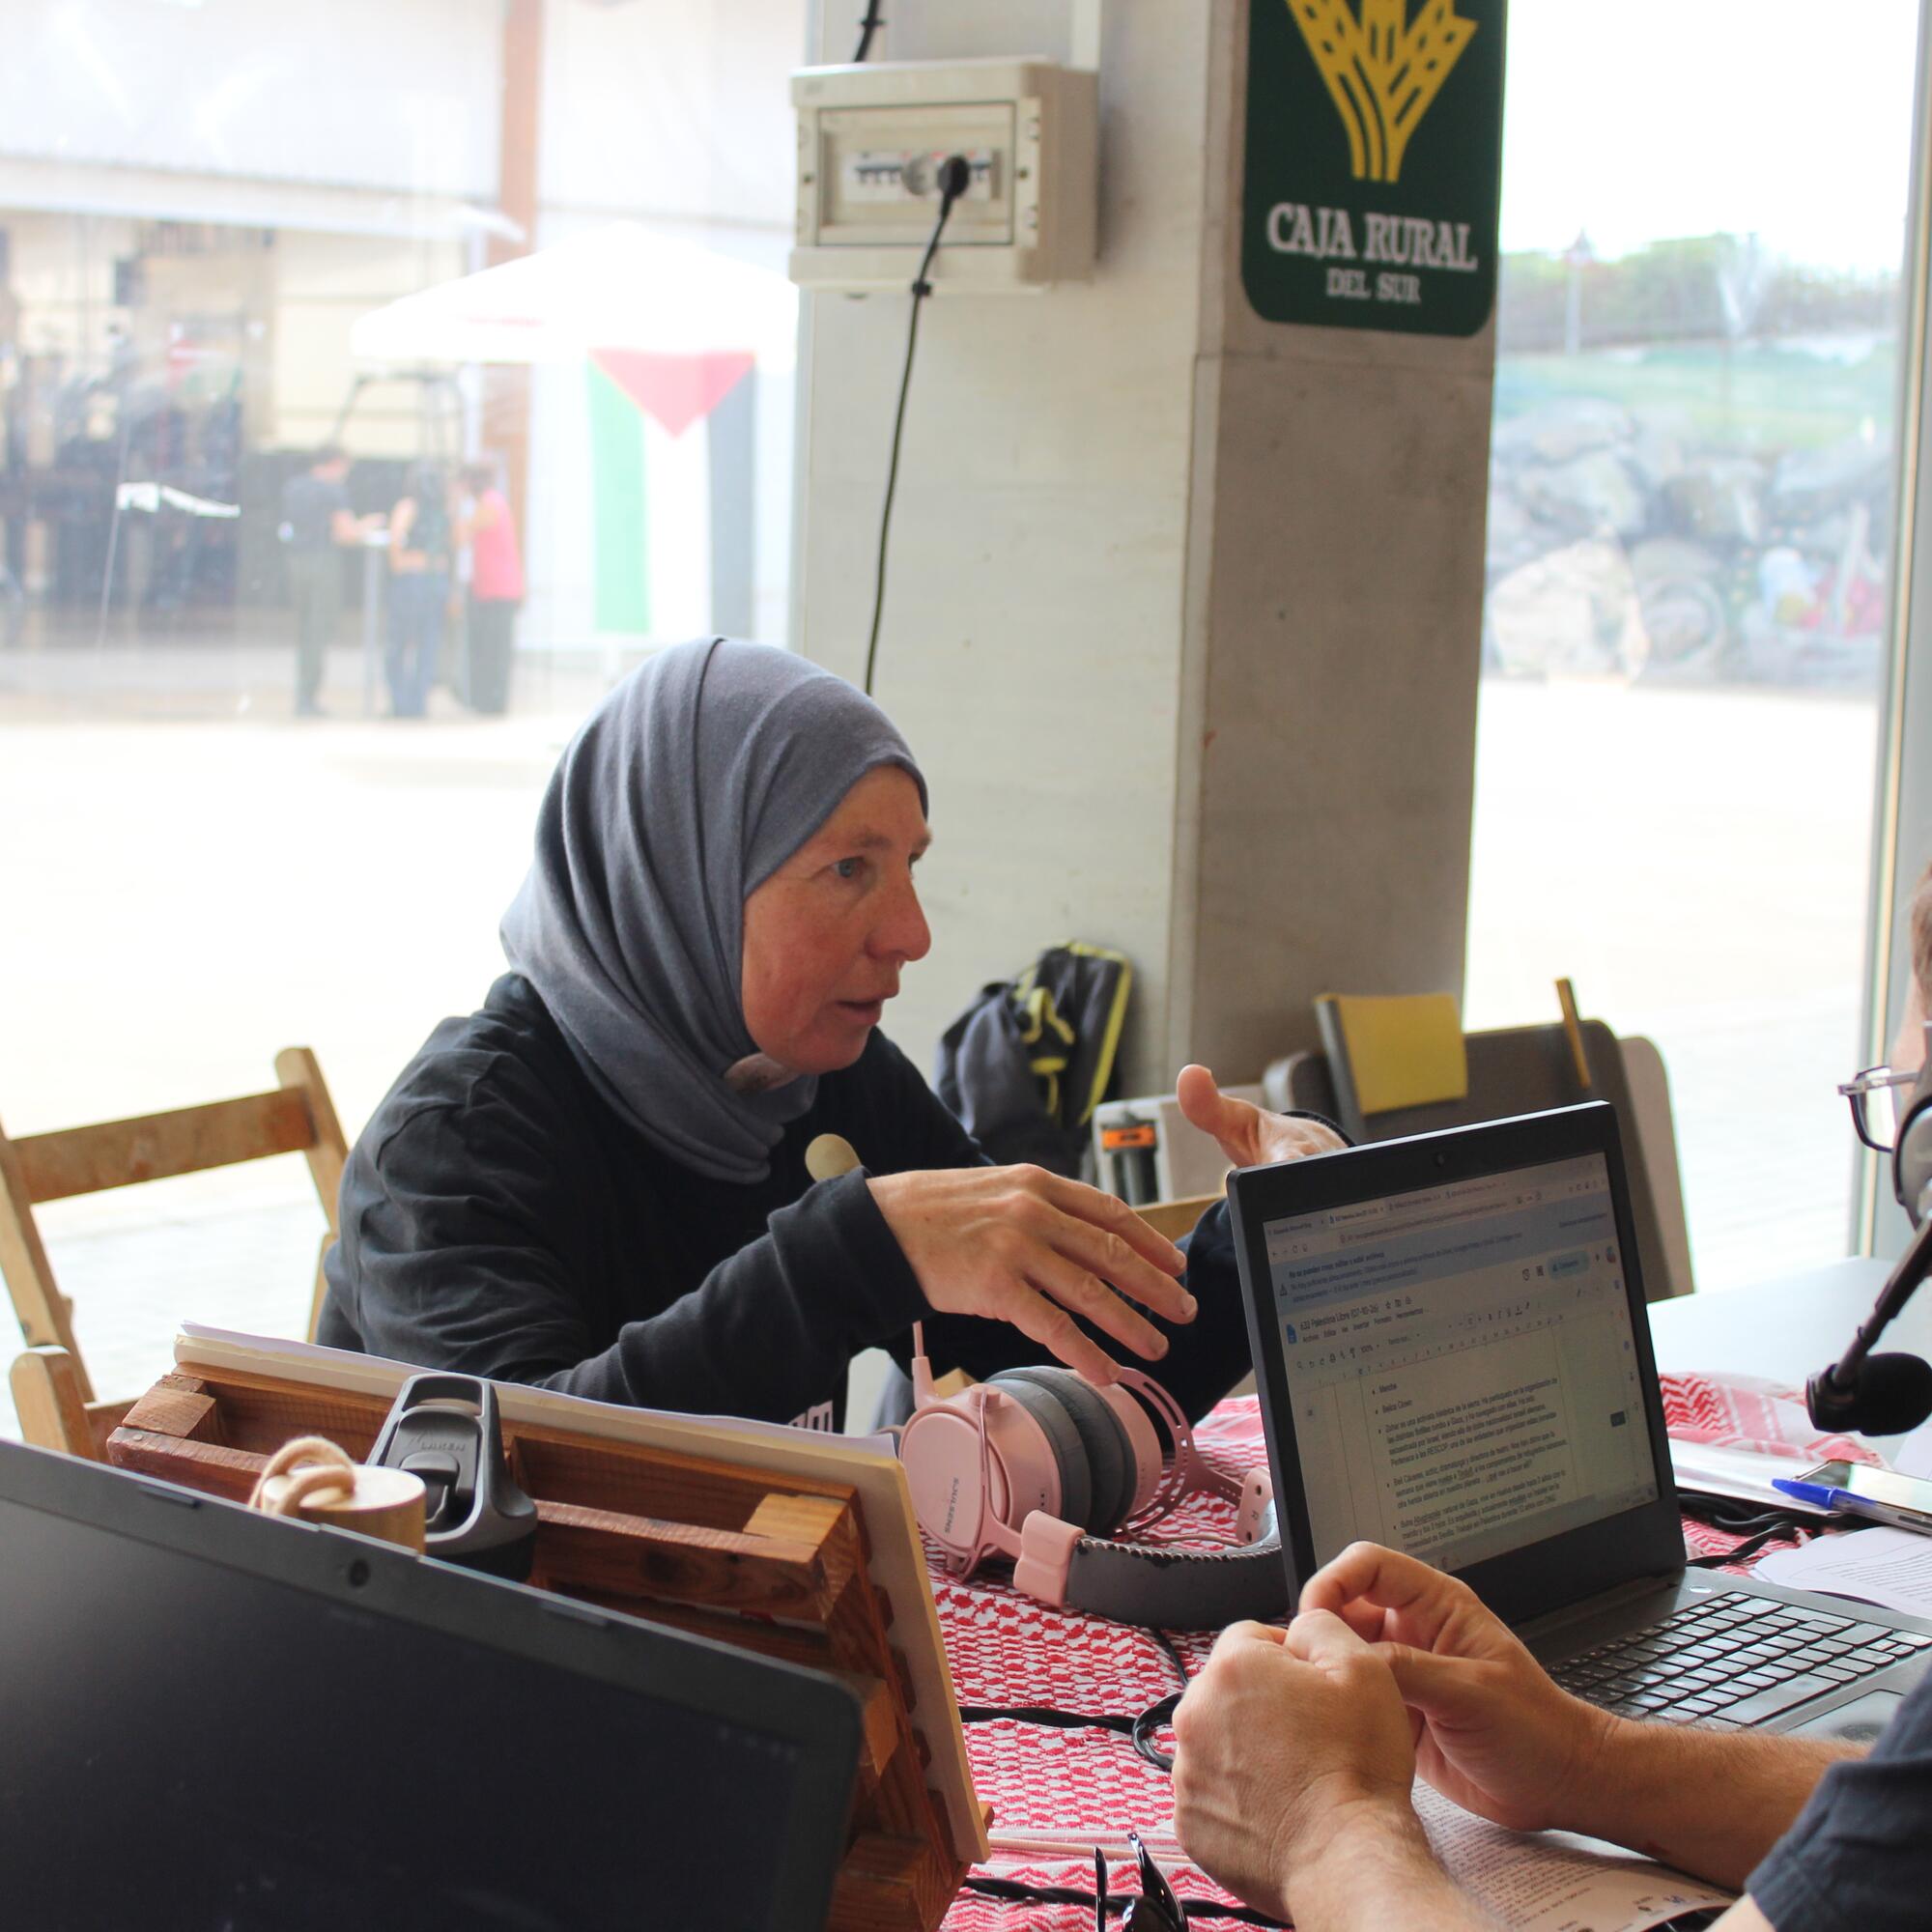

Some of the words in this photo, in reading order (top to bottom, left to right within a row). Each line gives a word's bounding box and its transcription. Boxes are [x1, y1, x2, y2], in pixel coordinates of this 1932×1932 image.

[1267, 202, 1356, 258] CAJA
[1365, 213, 1478, 271] RURAL
[1326, 268, 1371, 299] DEL
[1377, 272, 1420, 303] SUR
[1311, 1313, 1336, 1328] Palestina
[1335, 1310, 1350, 1322] Libre
